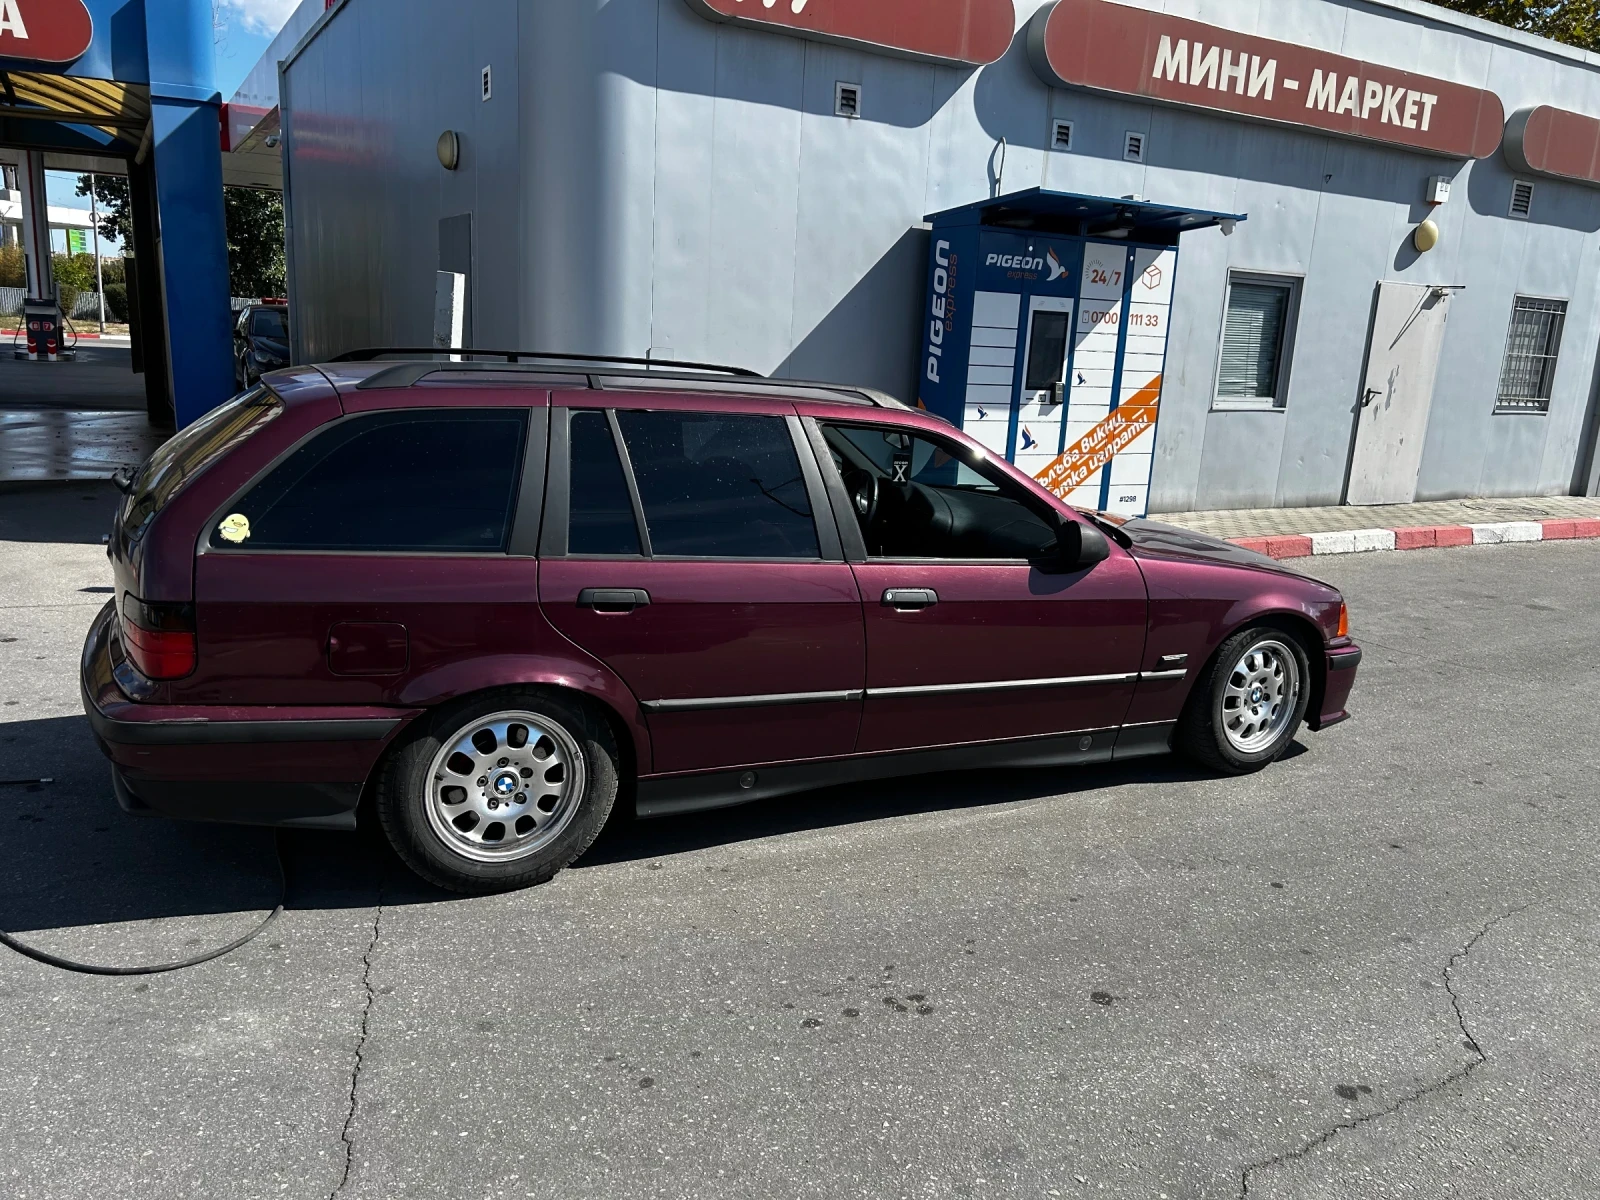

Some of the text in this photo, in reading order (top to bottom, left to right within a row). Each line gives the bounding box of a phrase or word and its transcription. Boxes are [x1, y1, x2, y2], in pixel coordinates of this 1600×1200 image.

[1152, 34, 1438, 131] МИНИ - МАРКЕТ
[985, 253, 1043, 271] PIGEON
[1006, 270, 1038, 280] express
[1090, 268, 1122, 287] 24/7
[945, 253, 957, 332] express
[926, 239, 950, 384] PIGEON
[1091, 311, 1158, 327] 0700 111 33
[1034, 449, 1080, 487] ълъба
[1053, 414, 1148, 498] атка изпрати
[893, 465, 908, 482] X
